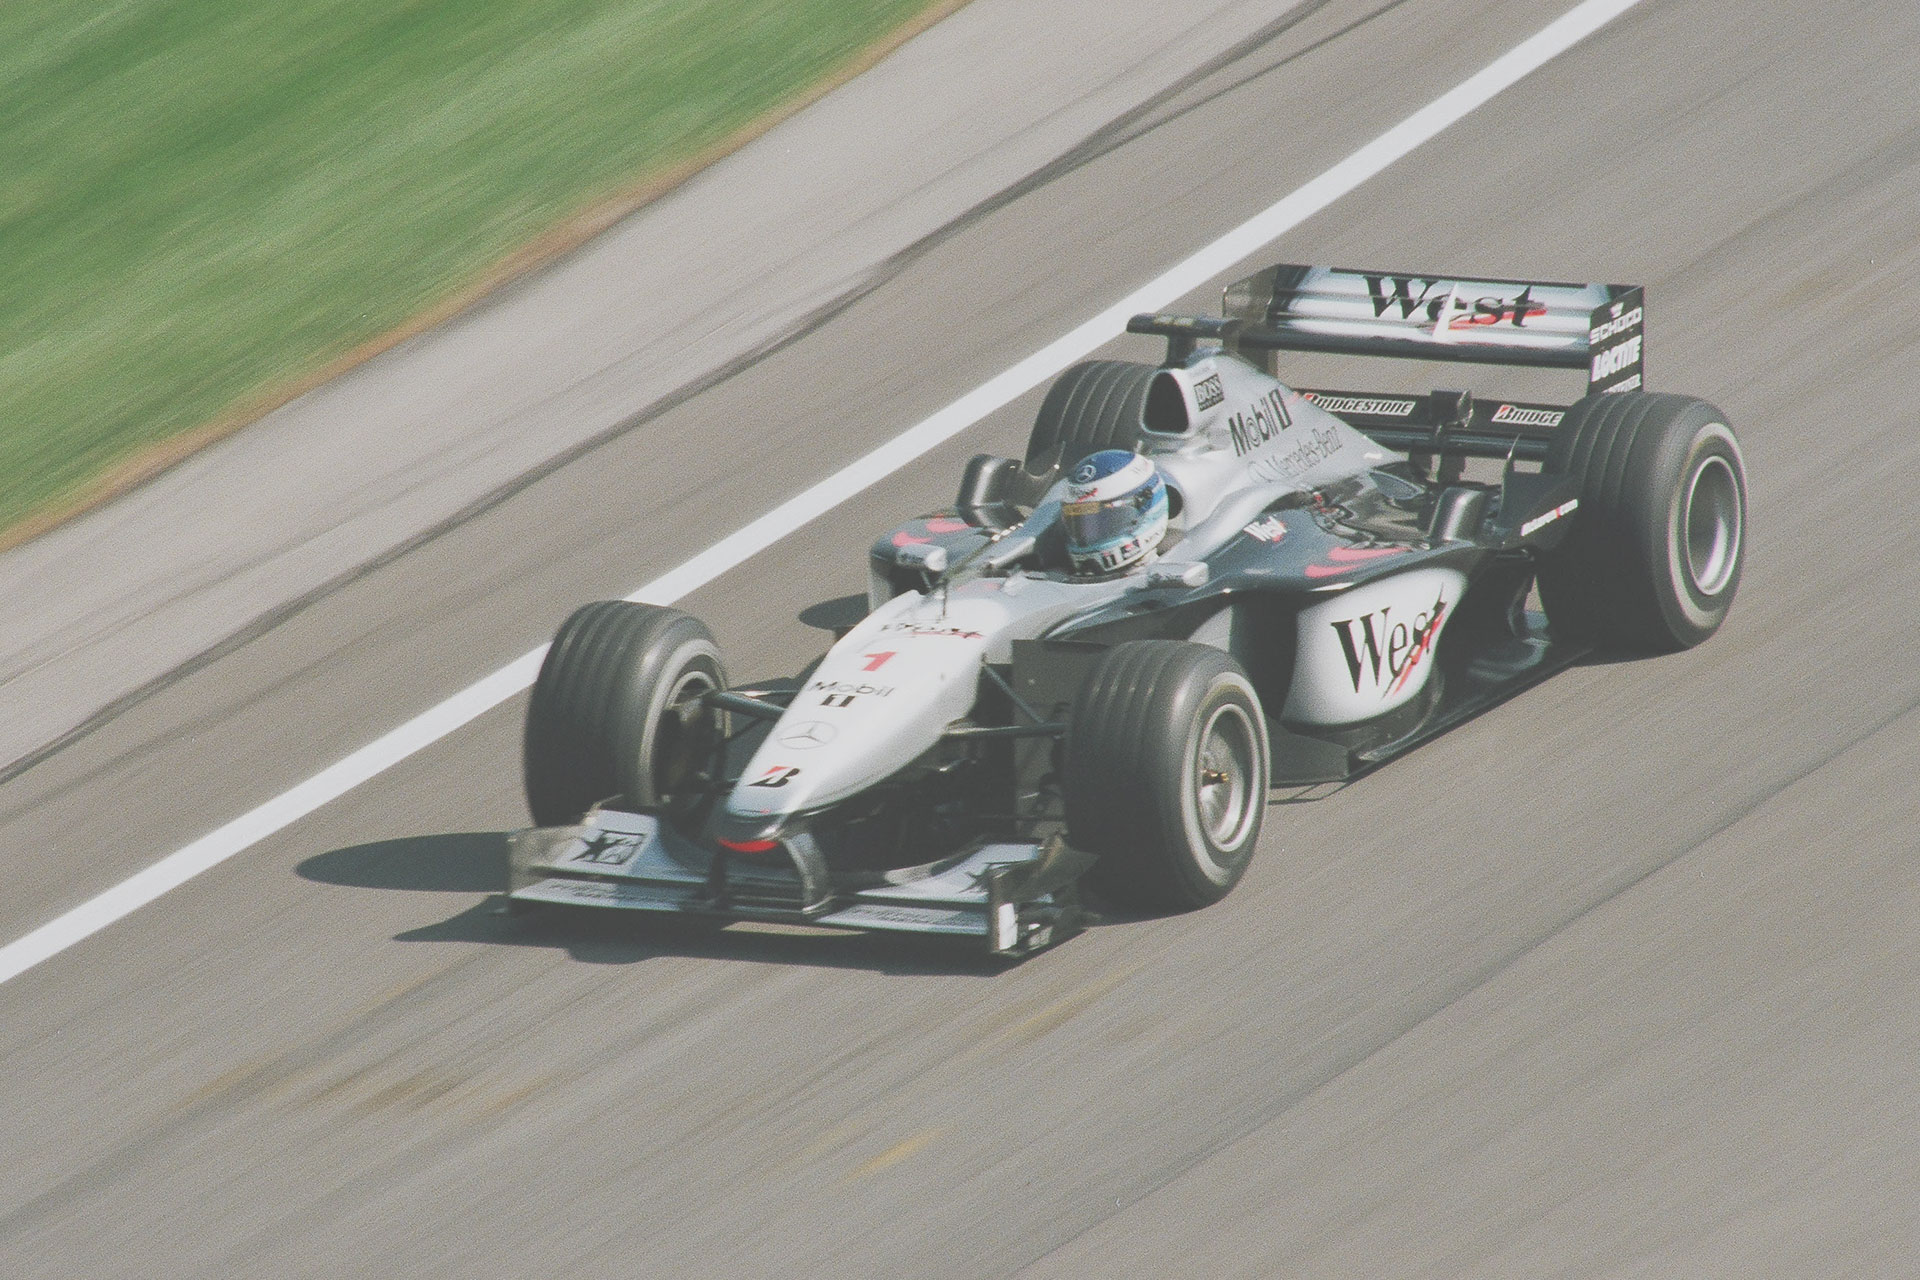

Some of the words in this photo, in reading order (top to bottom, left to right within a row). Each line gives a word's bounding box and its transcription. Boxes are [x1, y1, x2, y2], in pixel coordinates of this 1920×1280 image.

[1362, 275, 1545, 329] West
[1228, 396, 1279, 457] Mobil
[1497, 405, 1563, 425] BRIDGE
[1330, 582, 1447, 697] West
[861, 651, 896, 672] 1
[812, 681, 895, 697] Mobil
